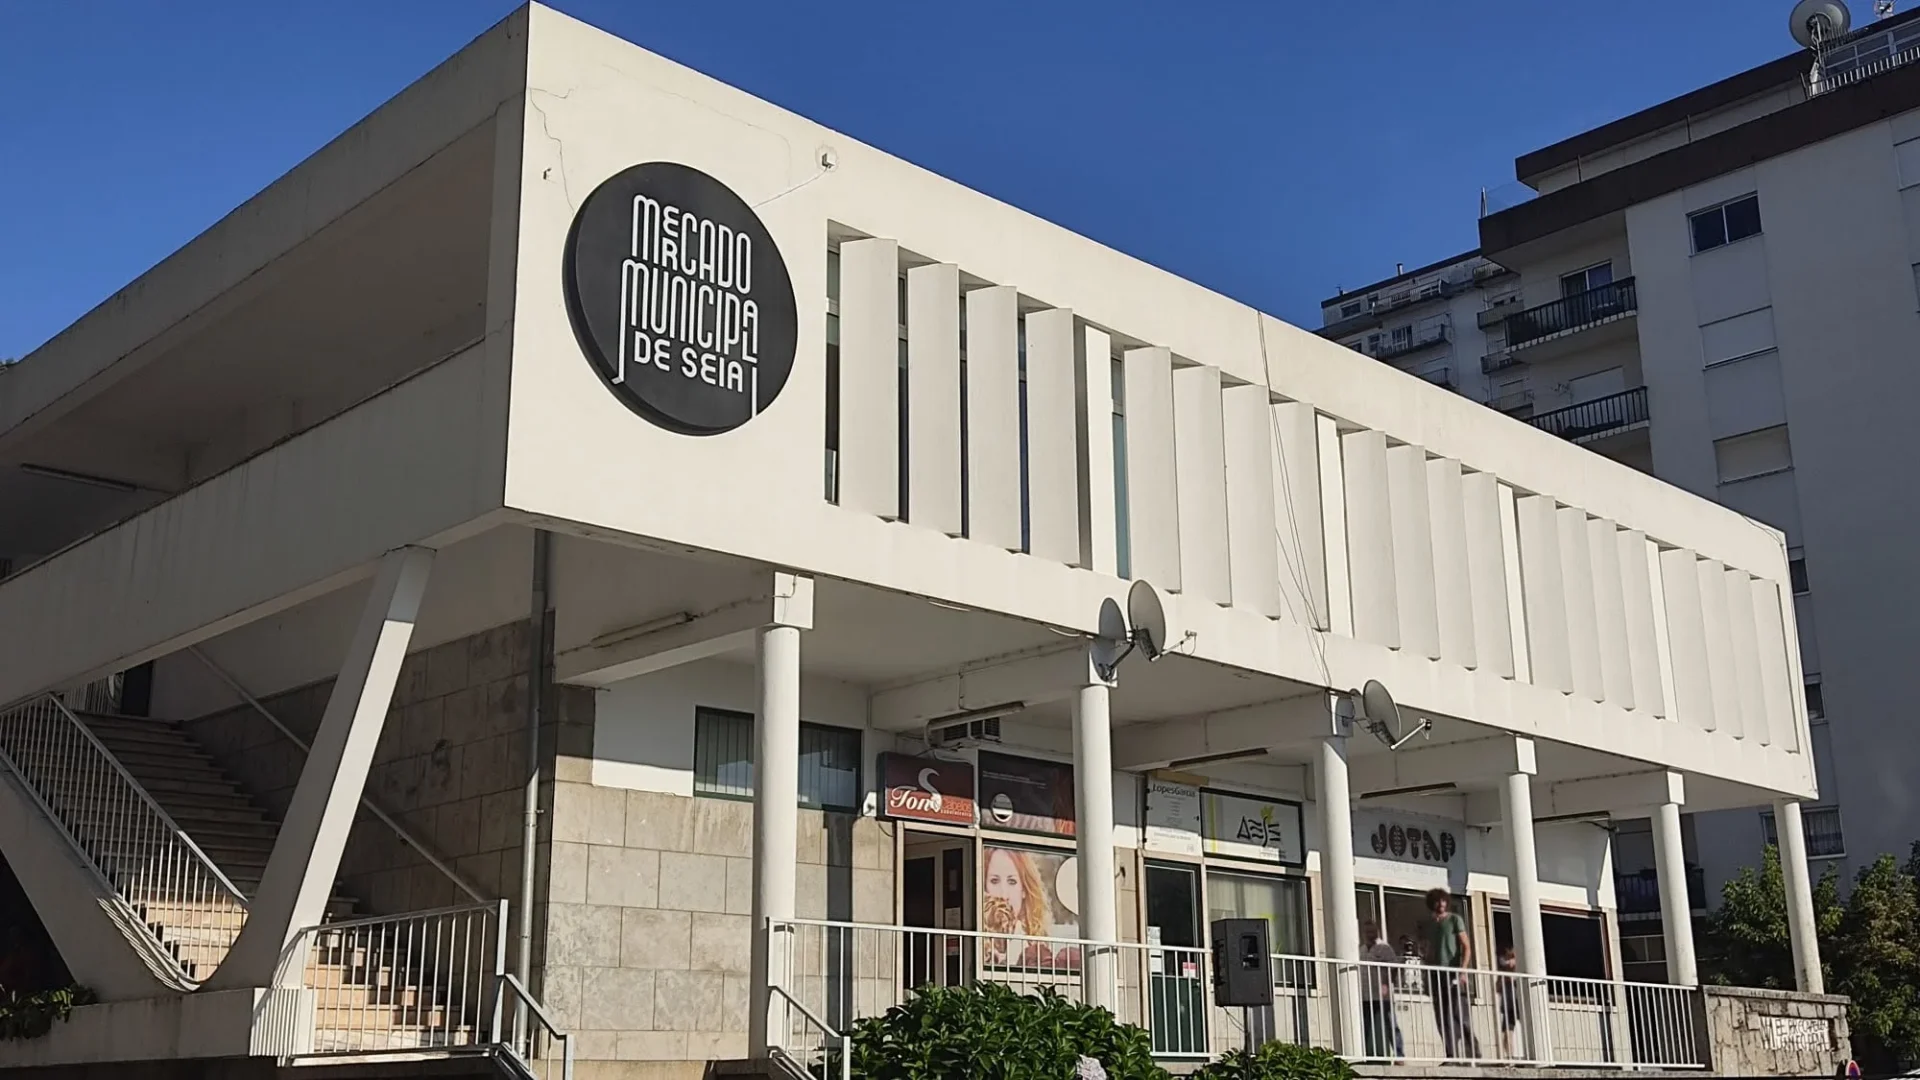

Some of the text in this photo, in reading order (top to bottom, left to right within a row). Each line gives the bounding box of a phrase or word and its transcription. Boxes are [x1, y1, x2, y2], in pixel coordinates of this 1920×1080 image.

[632, 194, 751, 294] MERCADO
[619, 258, 758, 372] MUNICIPAL
[634, 330, 743, 393] DE SEIA
